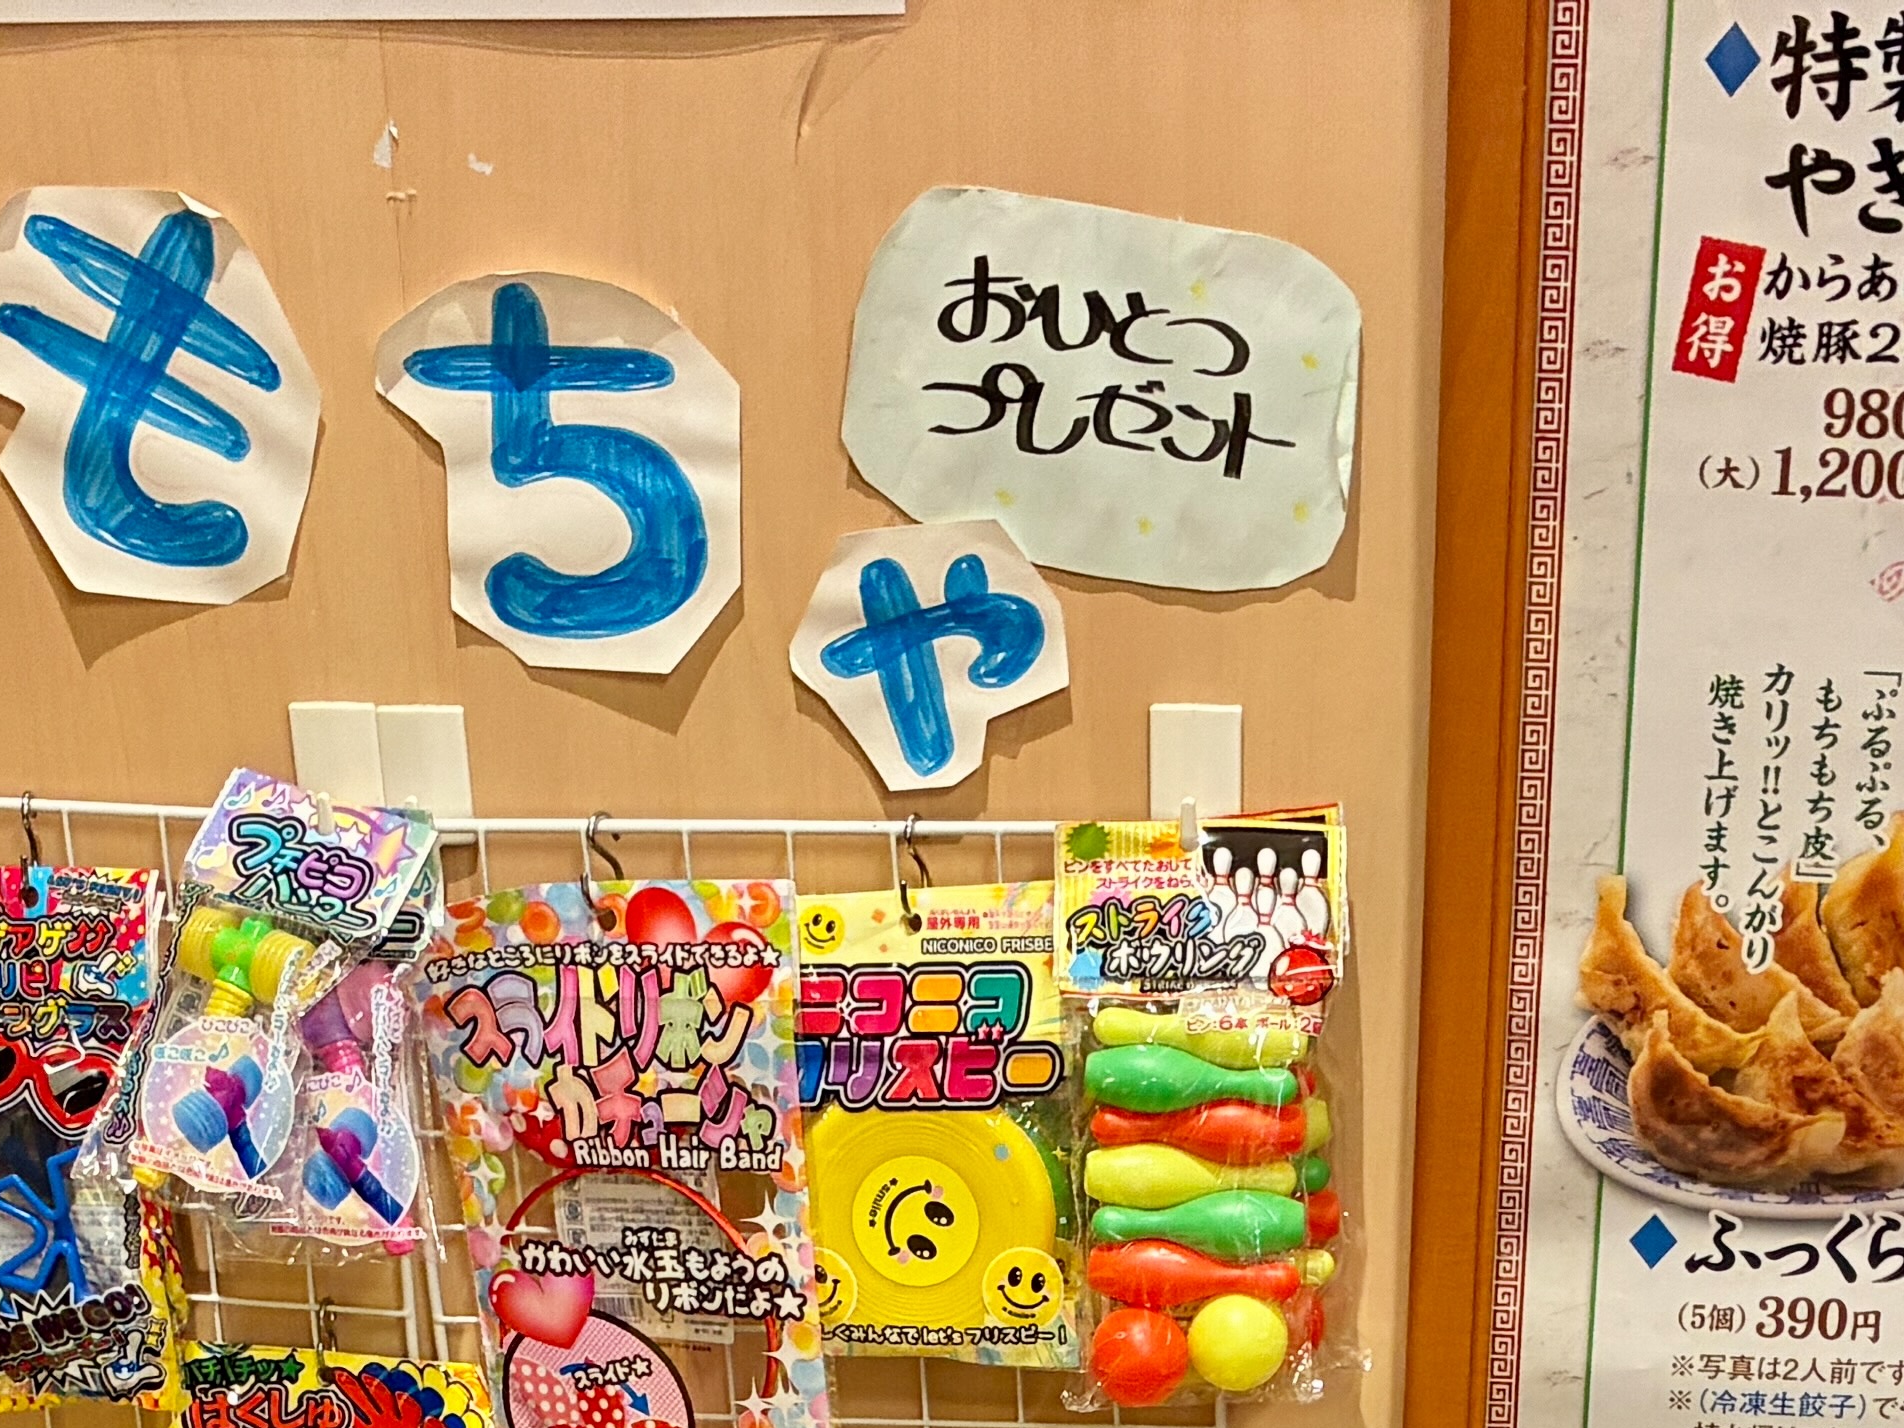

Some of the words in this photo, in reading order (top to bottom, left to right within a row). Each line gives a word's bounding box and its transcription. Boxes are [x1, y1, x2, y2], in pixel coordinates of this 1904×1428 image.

[938, 256, 1251, 378] おひとつ
[1688, 253, 1745, 369] お得
[926, 362, 1294, 480] プレゼント
[1700, 673, 1745, 908] 焼き上げます。
[1064, 860, 1191, 873] ピンをすべてたおして
[1068, 896, 1221, 943] ストライク
[922, 938, 996, 954] NICONICO
[1107, 933, 1264, 978] ボウリング
[447, 965, 751, 1068] スライドリボン
[797, 971, 1023, 1035] ニコニコ
[548, 1049, 773, 1150] カチューシャ
[575, 1139, 649, 1168] Ribbon
[660, 1136, 710, 1168] Hair
[720, 1137, 782, 1170] Band
[522, 1244, 785, 1282] かわいい水玉もようの
[645, 1282, 773, 1317] リボンだよ
[1755, 1296, 1881, 1343] 390円
[921, 1326, 963, 1344] let's
[575, 1359, 630, 1389] スライド
